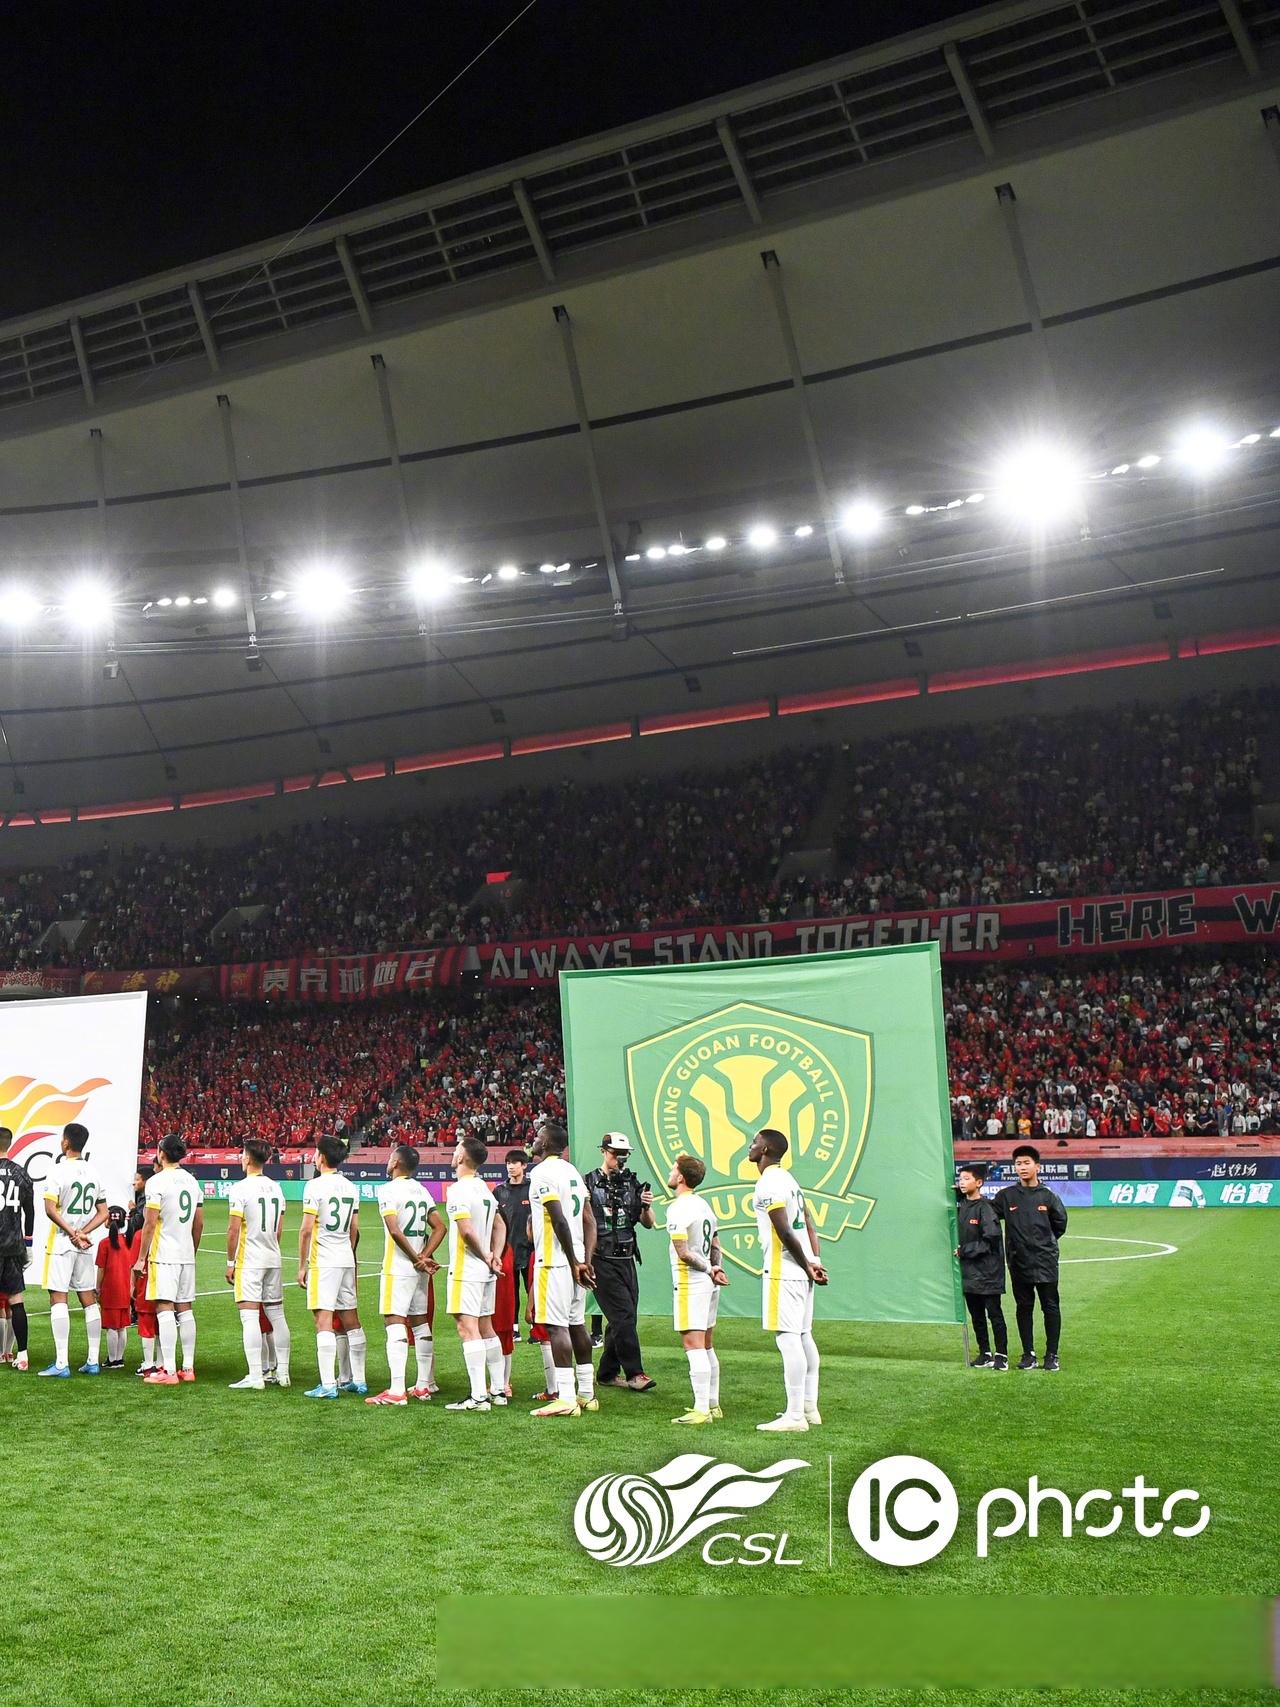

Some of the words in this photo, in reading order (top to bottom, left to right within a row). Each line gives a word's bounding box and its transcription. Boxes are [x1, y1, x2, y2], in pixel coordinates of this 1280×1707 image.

[490, 939, 631, 981] ALWAYS
[653, 930, 773, 966] STAND
[1057, 893, 1198, 948] HERE
[676, 1034, 741, 1081] GUOAN
[749, 1033, 835, 1103] FOOTBALL
[815, 1109, 839, 1162] CLUB
[66, 1181, 96, 1216] 26
[178, 1189, 192, 1224] 9
[1108, 1182, 1160, 1204] 怡寶
[1220, 1182, 1274, 1204] 怡寶
[257, 1197, 280, 1233] 11
[325, 1196, 355, 1233] 37
[402, 1200, 428, 1237] 23
[482, 1199, 492, 1227] 7
[701, 1219, 711, 1259] 8
